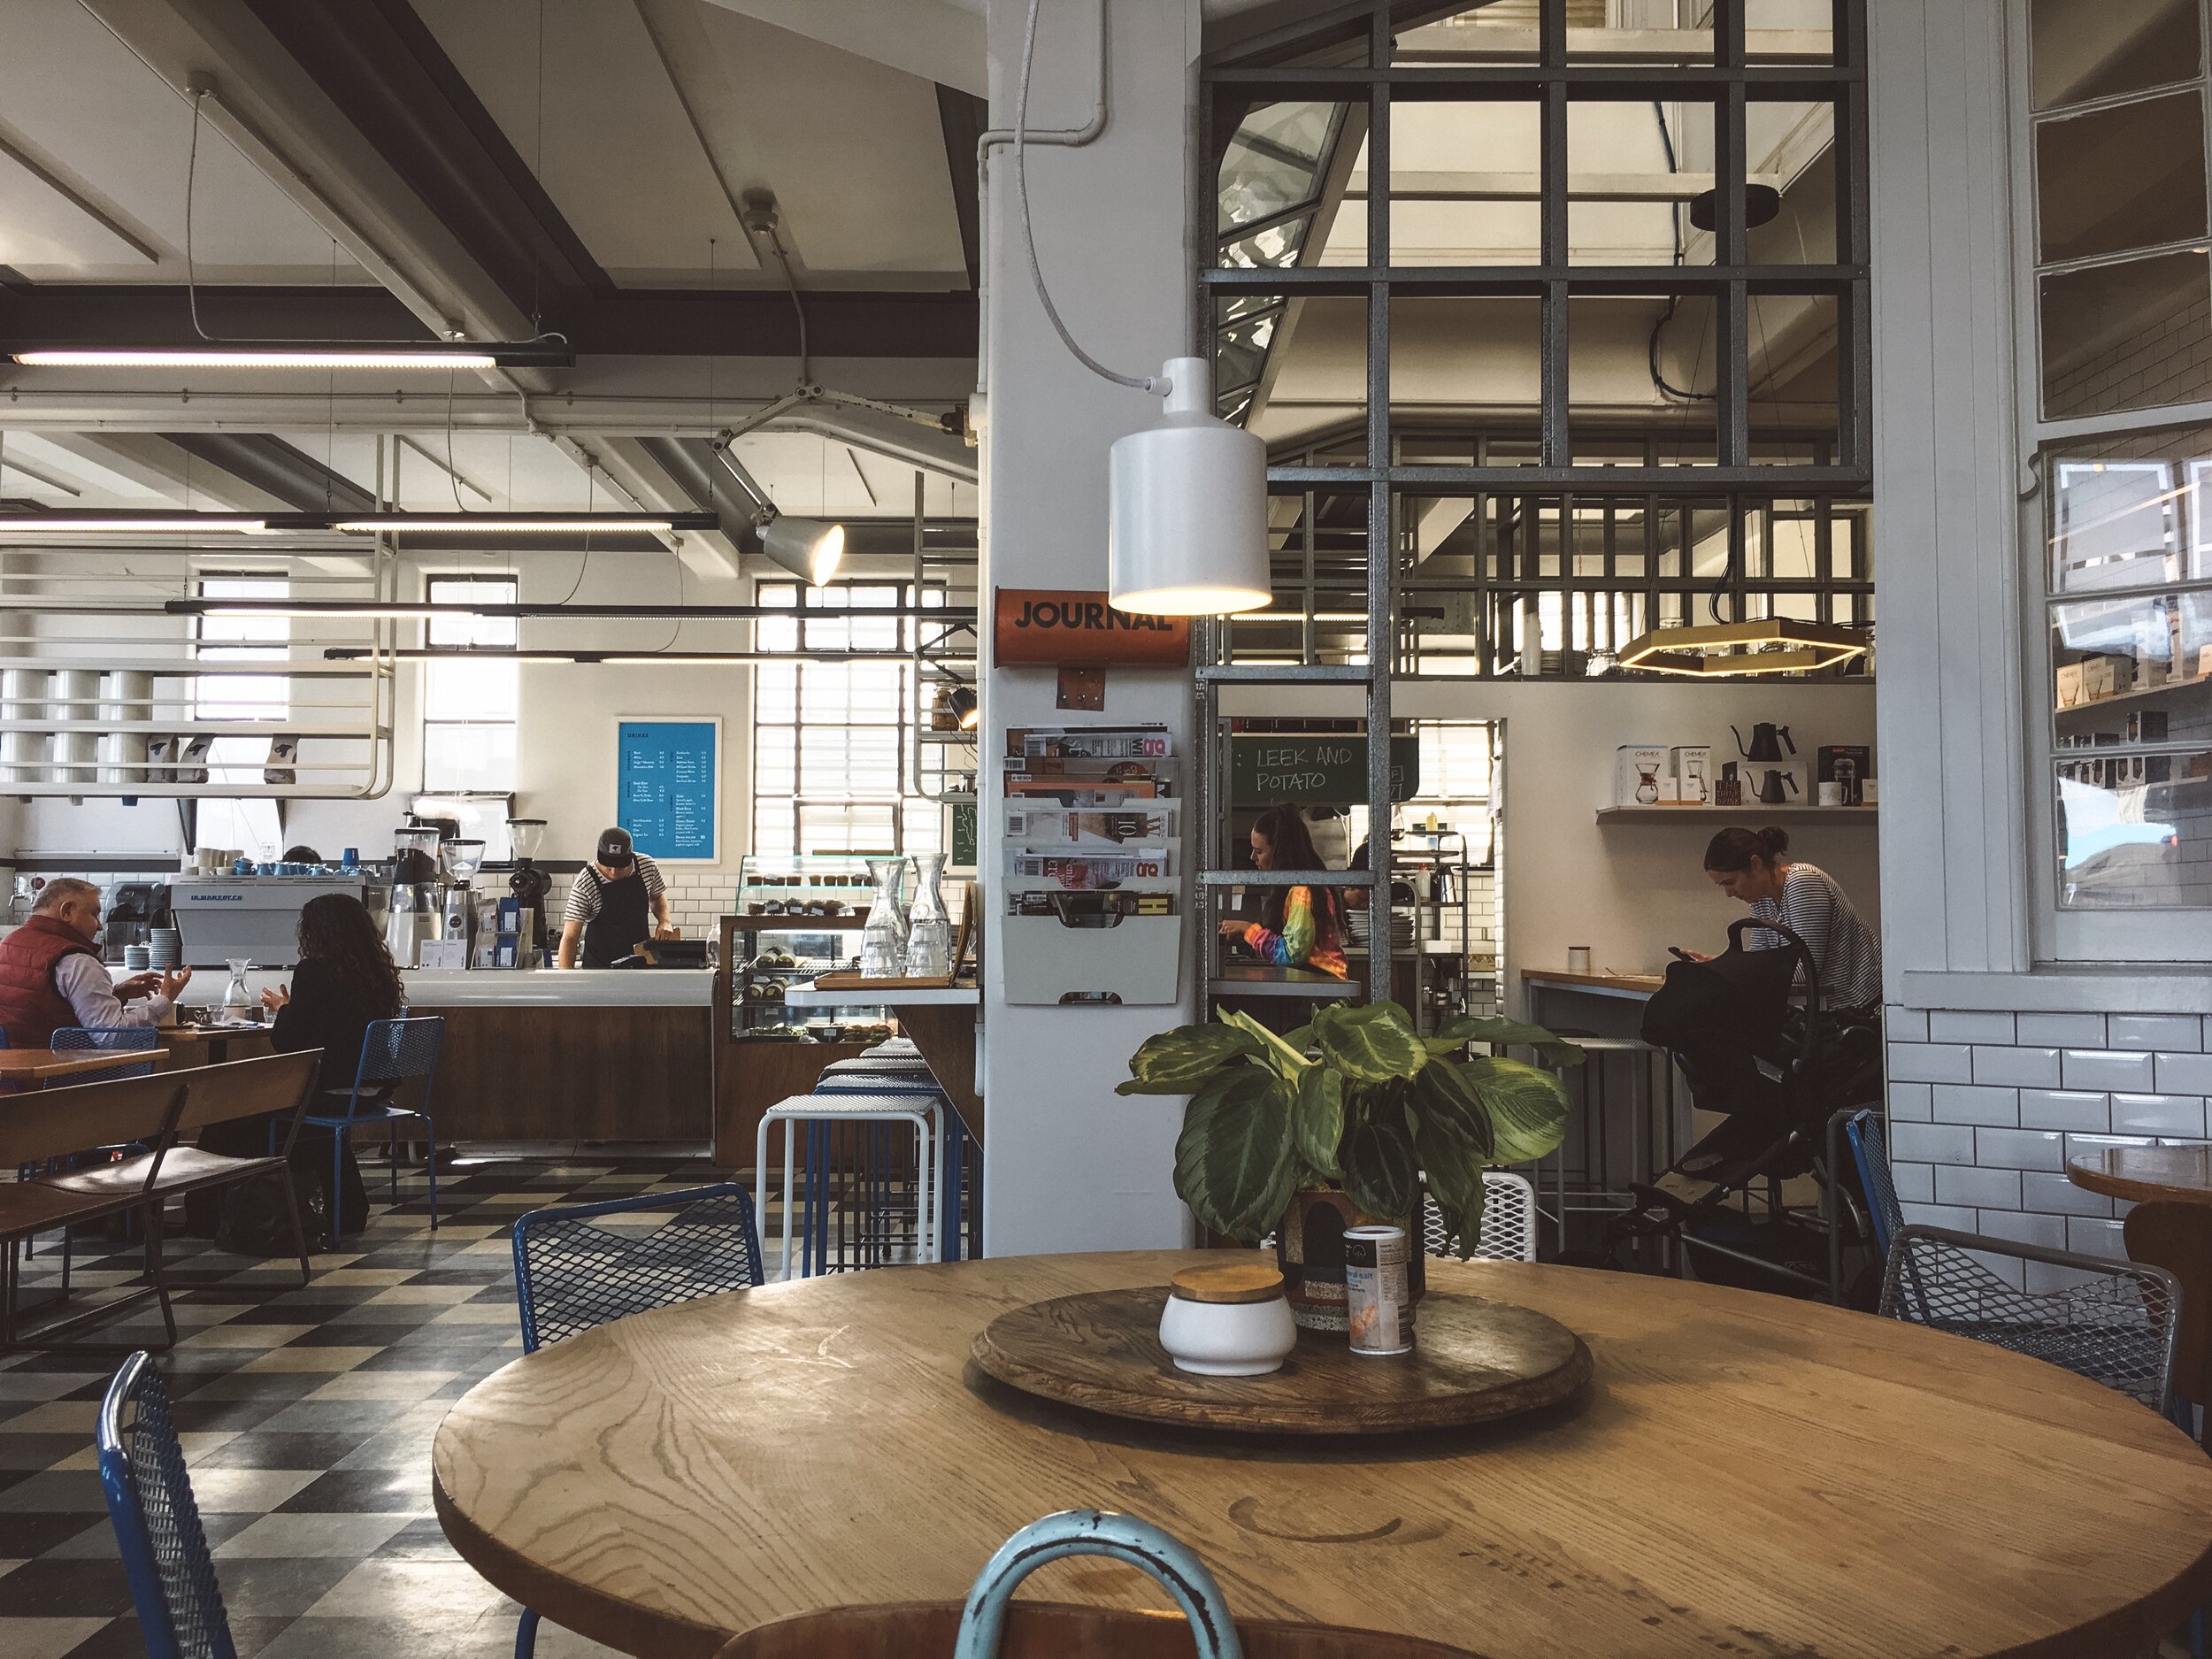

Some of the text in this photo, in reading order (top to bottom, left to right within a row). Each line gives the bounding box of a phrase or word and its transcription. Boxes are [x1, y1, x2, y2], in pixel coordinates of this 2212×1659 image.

[1015, 601, 1172, 631] JOURNAL
[1256, 749, 1309, 768] LEEK
[1316, 746, 1353, 766] AND
[1256, 772, 1326, 791] POTATO
